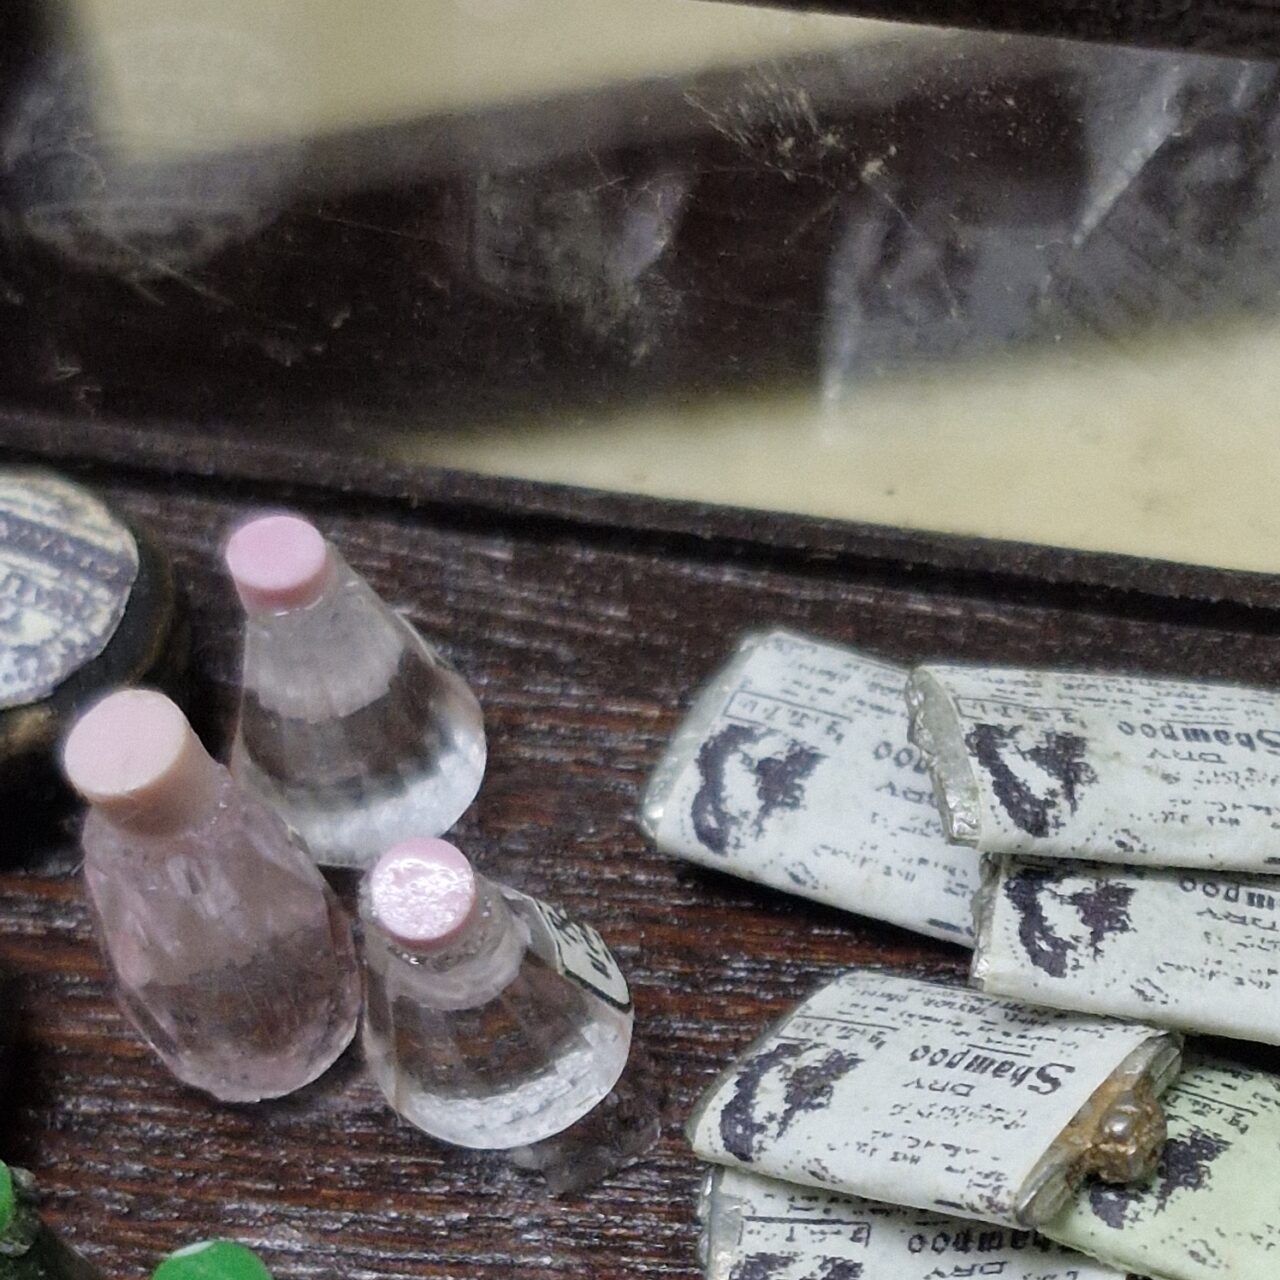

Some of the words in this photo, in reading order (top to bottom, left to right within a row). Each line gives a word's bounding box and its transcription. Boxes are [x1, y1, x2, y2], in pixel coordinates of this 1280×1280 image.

[909, 1046, 1075, 1096] Shampoo
[902, 1078, 974, 1098] DRY
[923, 1262, 1008, 1279] DRY
